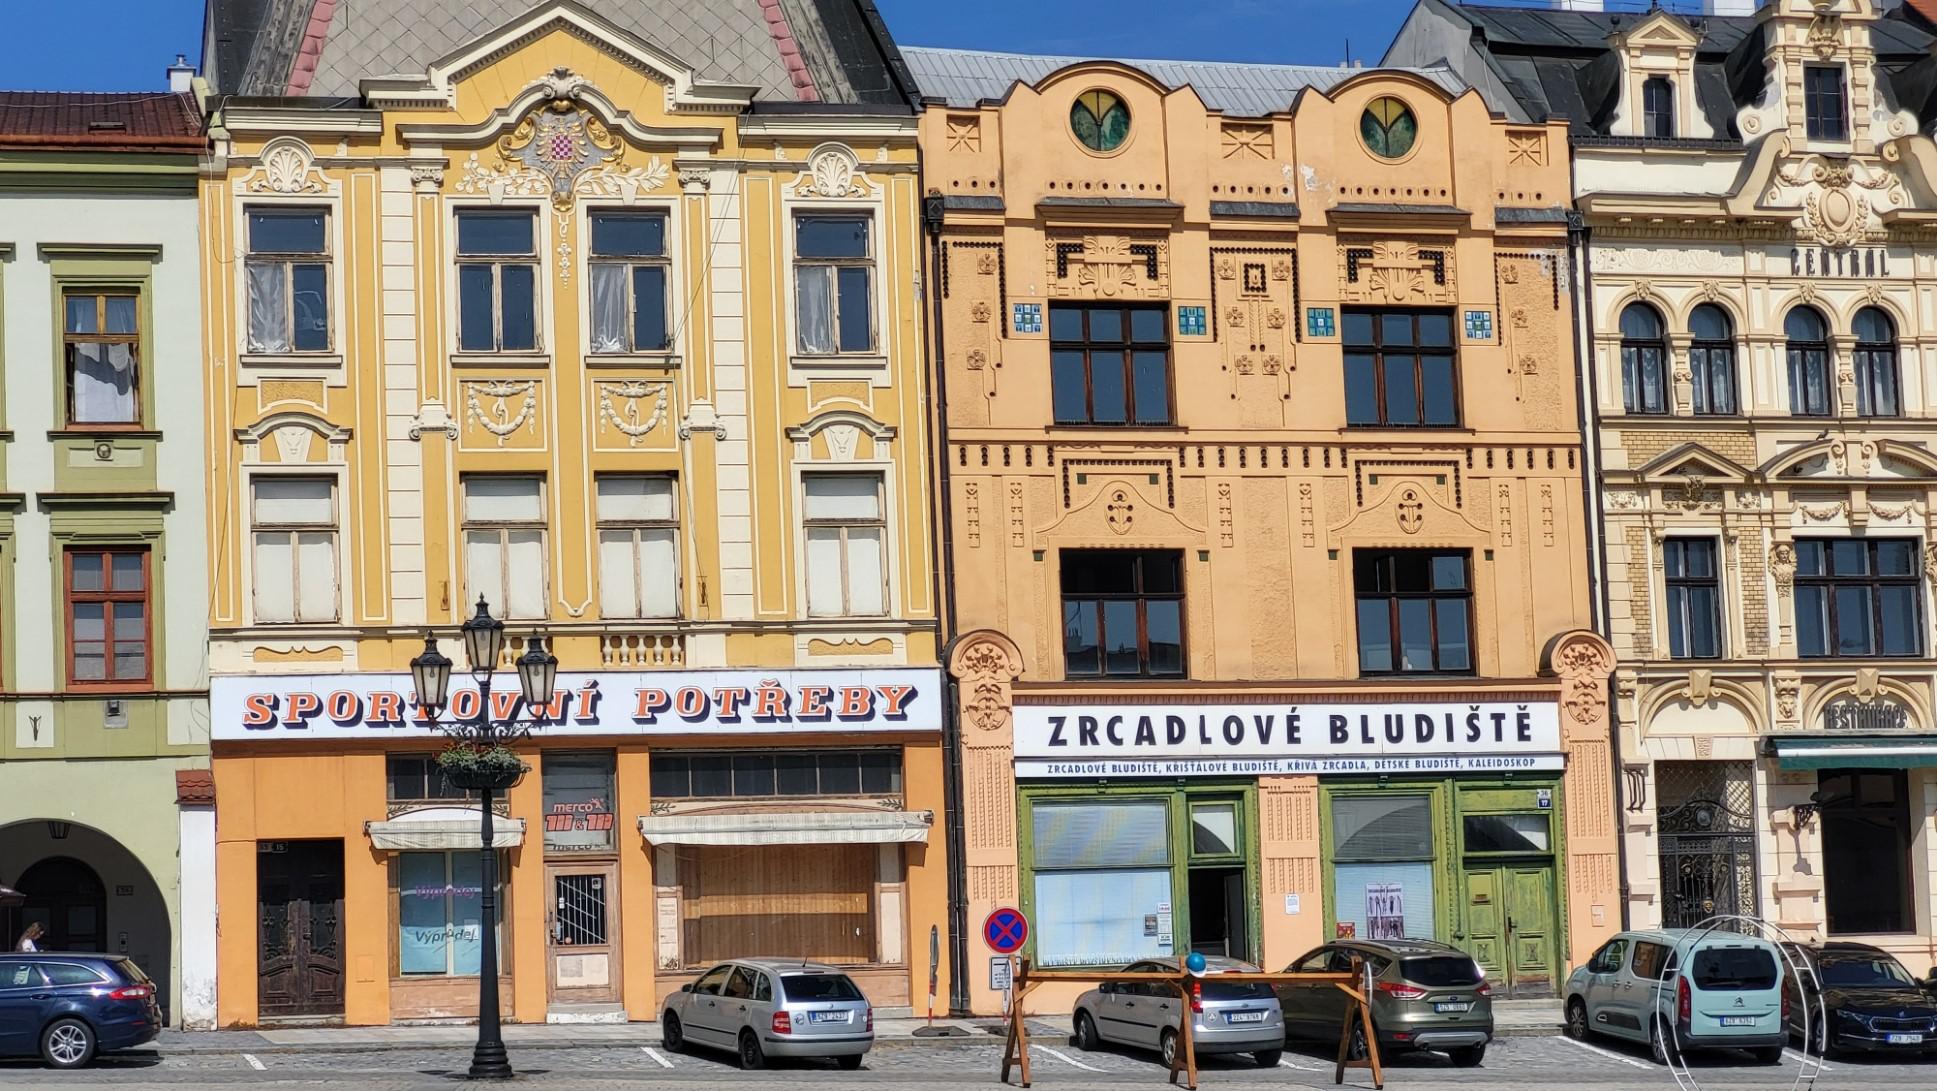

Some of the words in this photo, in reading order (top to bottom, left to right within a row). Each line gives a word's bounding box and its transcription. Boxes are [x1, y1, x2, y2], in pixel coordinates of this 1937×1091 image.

[1790, 247, 1889, 277] CENTRAL
[631, 678, 919, 724] POTŘEBY
[1047, 706, 1301, 747] ZRCADLOVÉ
[1329, 704, 1532, 744] BLUDIŠTĚ
[1047, 762, 1107, 774] ZRCADLOVÉ
[1112, 761, 1162, 774] BLUDIŠTĚ,
[1232, 759, 1283, 773] BLUDIŠTĚ,
[1287, 759, 1317, 771] KŘIVÁ
[1322, 759, 1370, 771] ZRCADLA,
[1375, 758, 1410, 769] DĚTSKÉ
[1415, 757, 1464, 769] BLUDIŠTĚ,
[1468, 757, 1536, 769] KALEIDOSKOP
[553, 803, 594, 813] merco
